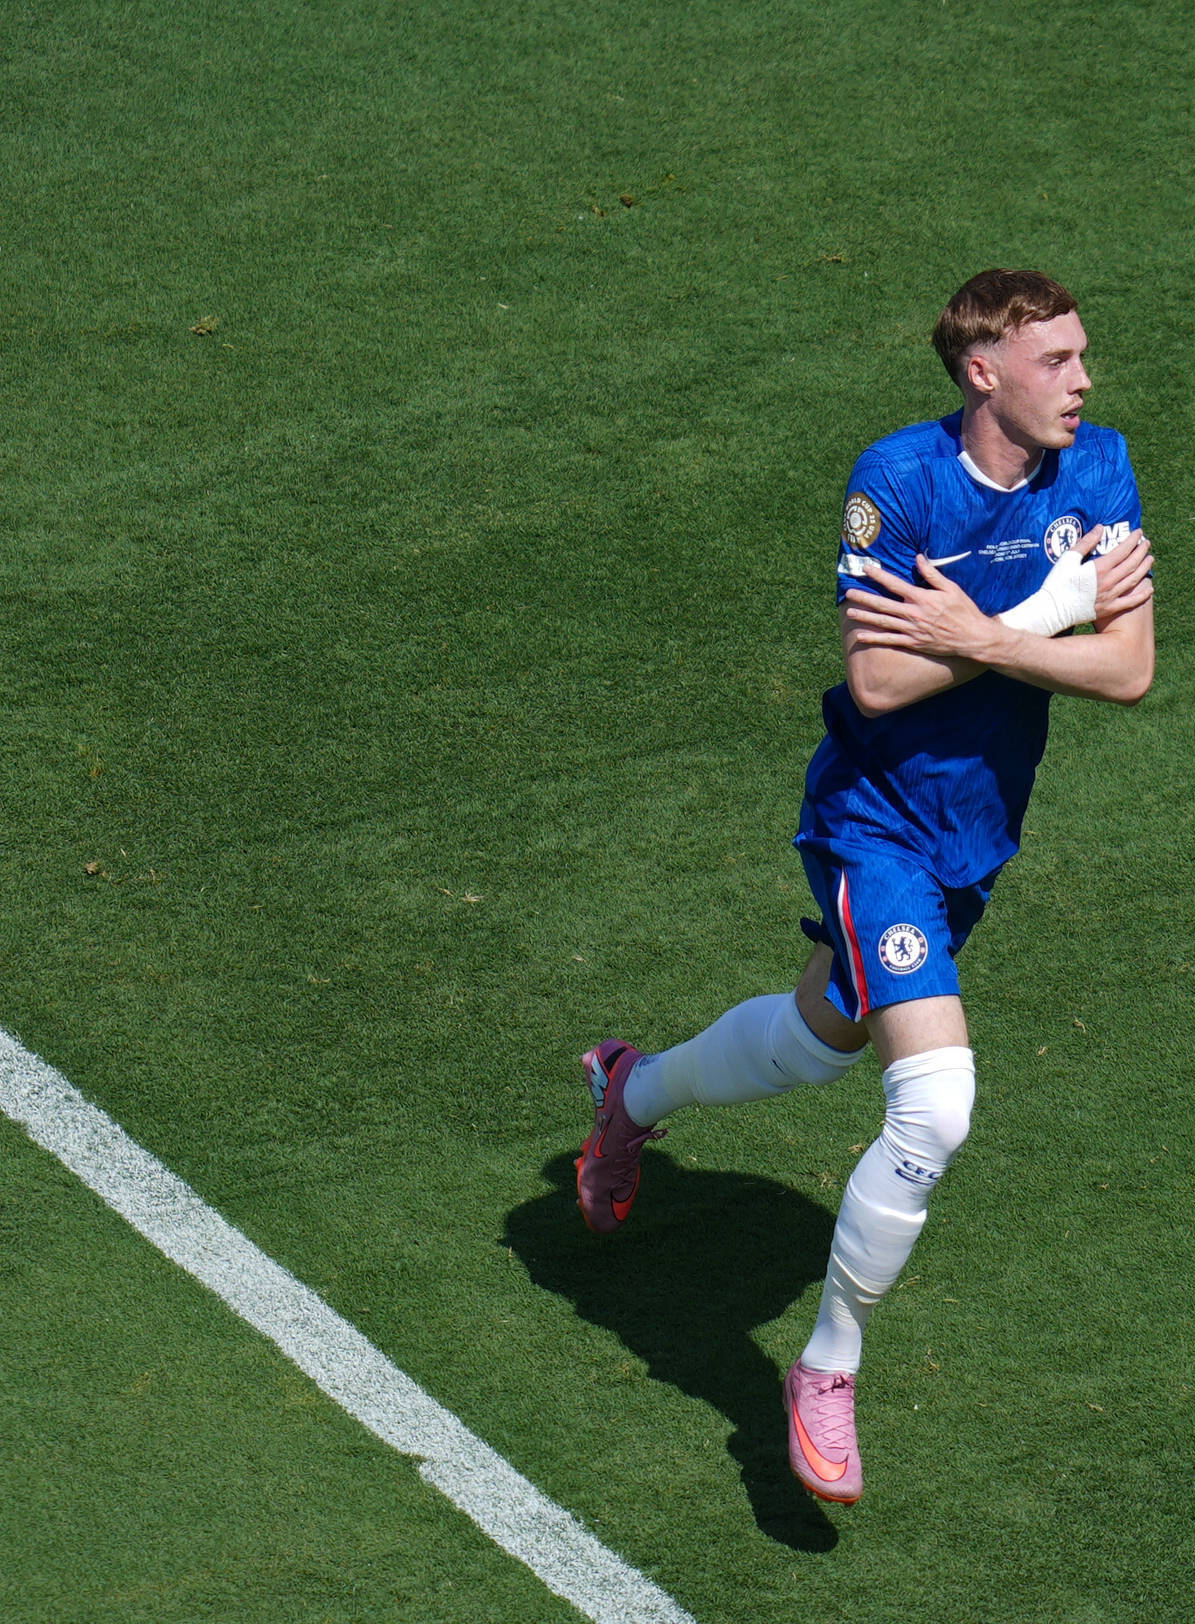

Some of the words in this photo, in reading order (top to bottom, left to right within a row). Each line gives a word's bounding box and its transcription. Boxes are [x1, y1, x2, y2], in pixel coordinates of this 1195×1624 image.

[861, 501, 873, 512] CUP
[1050, 516, 1078, 533] CHELSEA
[884, 925, 915, 940] CHELSEA
